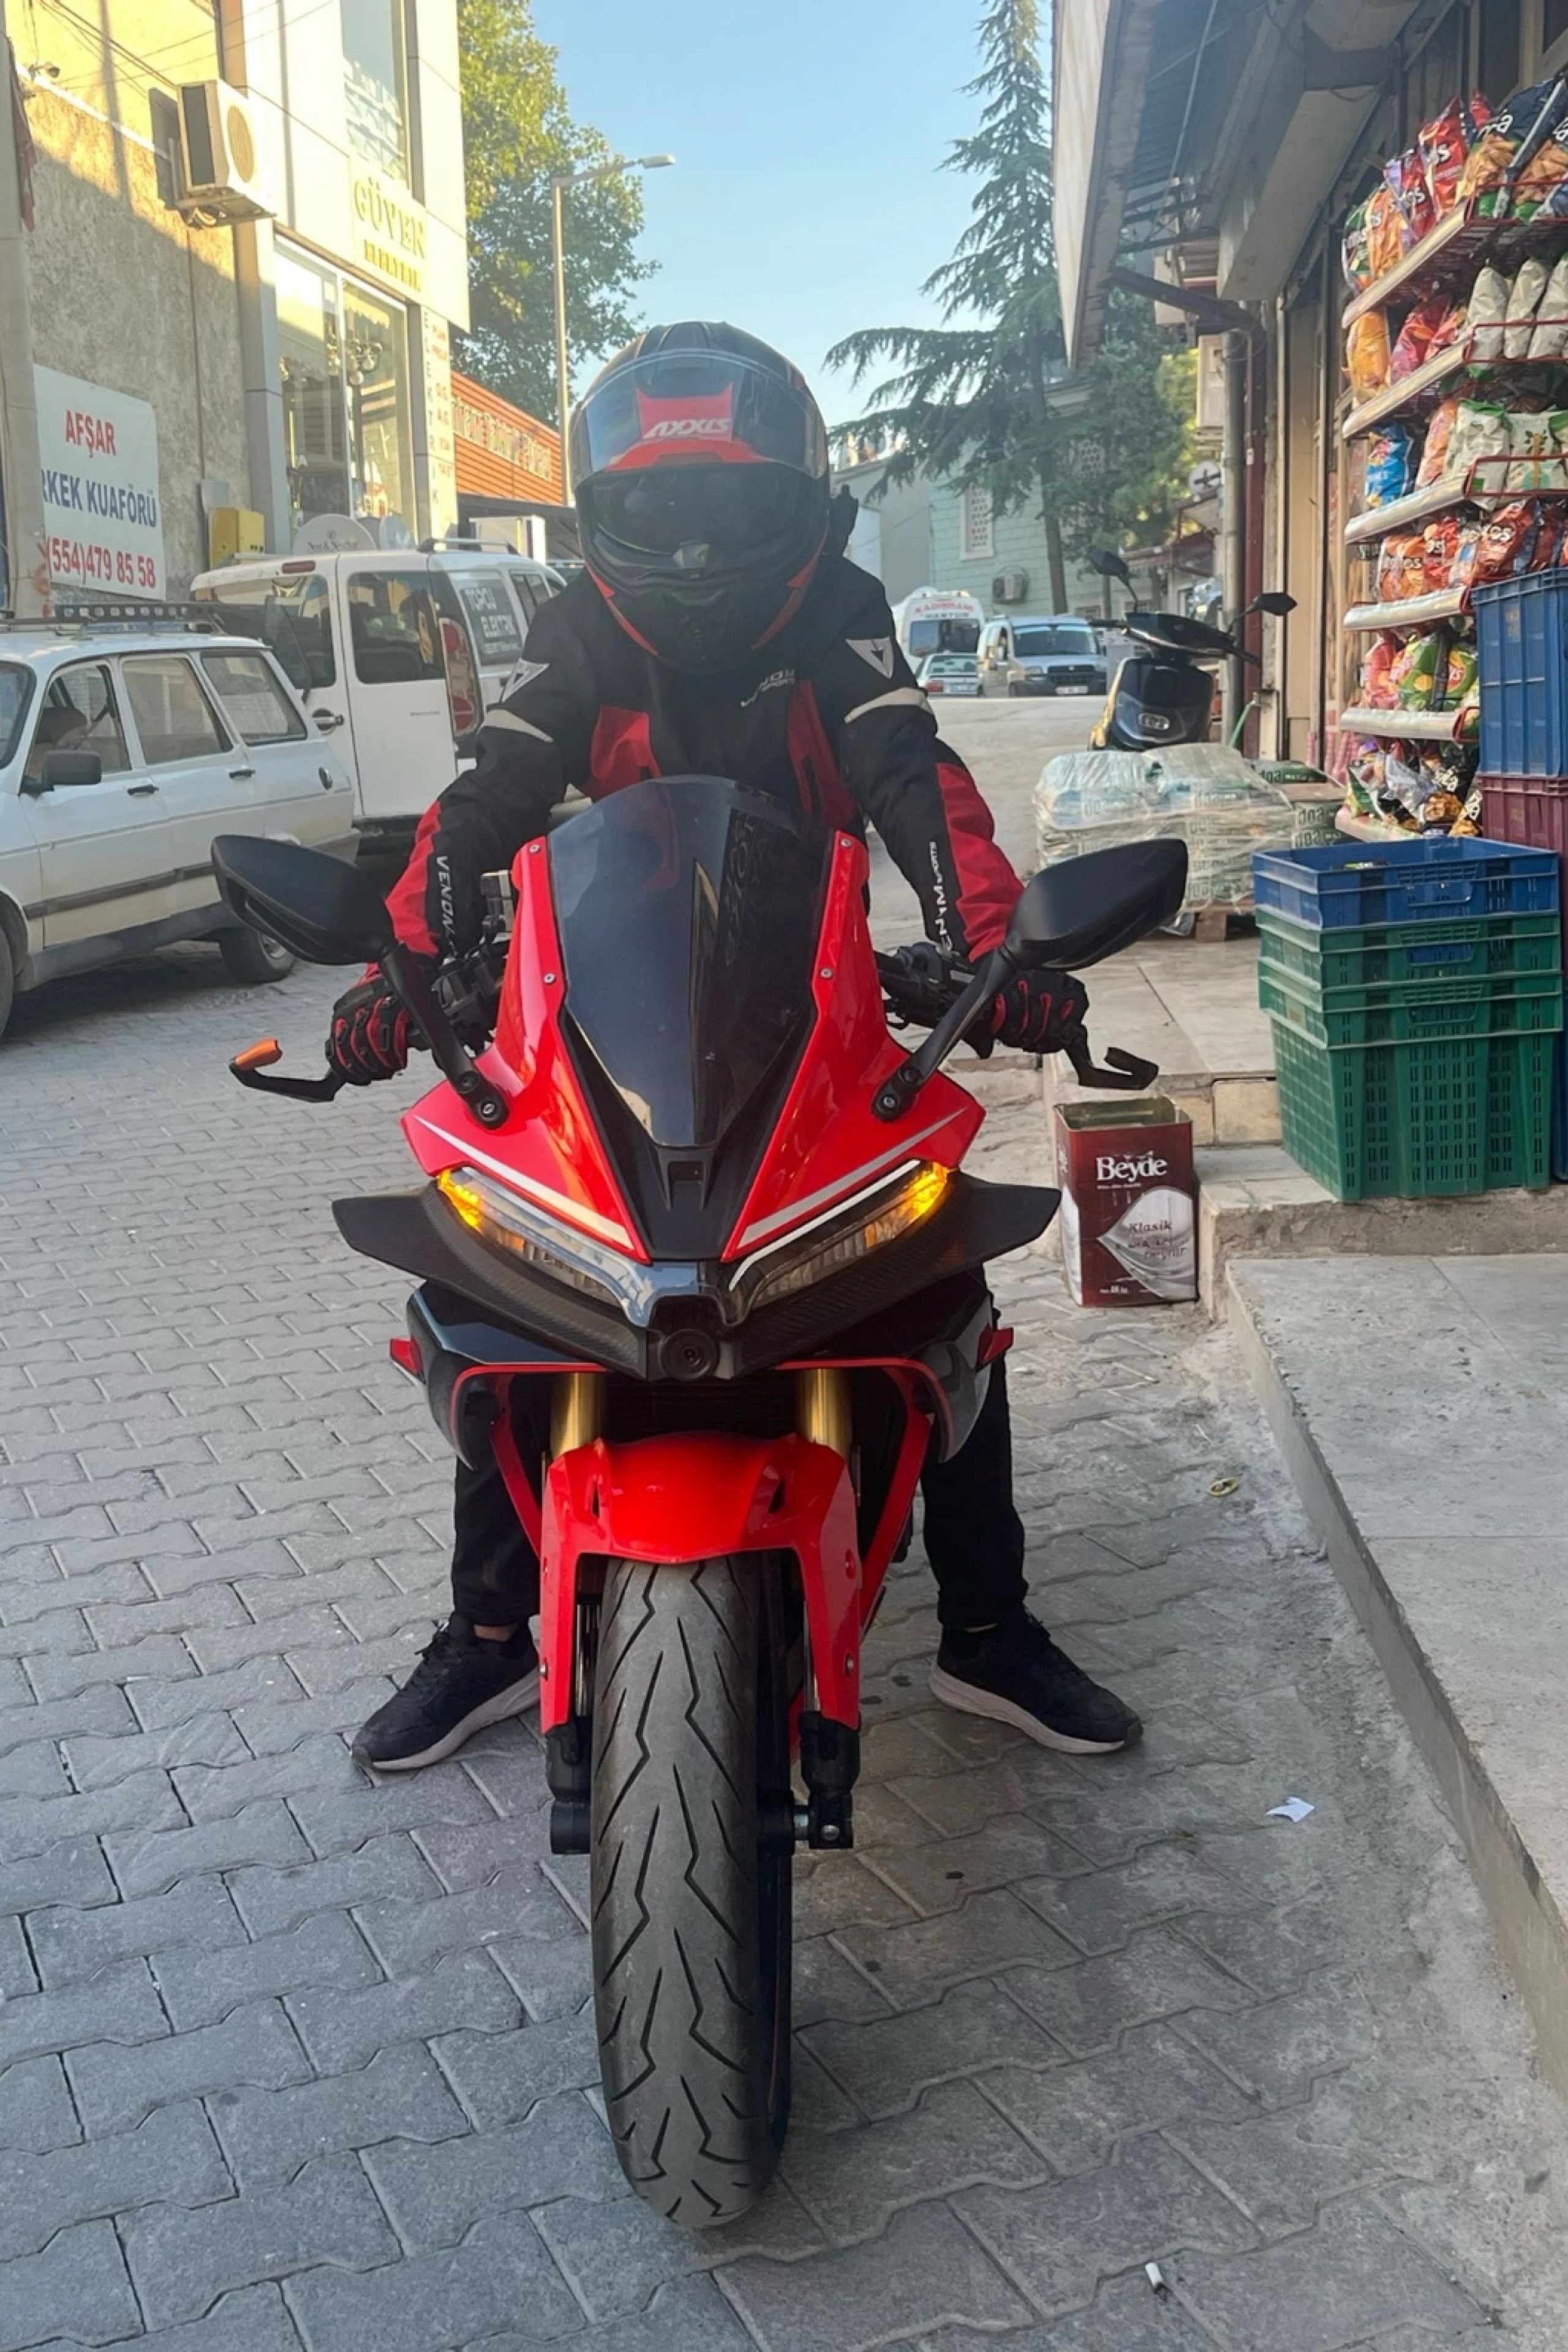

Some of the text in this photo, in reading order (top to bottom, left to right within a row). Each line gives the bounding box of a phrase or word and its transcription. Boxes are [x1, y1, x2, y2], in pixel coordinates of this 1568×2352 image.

[65, 410, 116, 458] AFŞAR
[643, 419, 731, 439] AXXIS
[86, 480, 157, 529] KUAFÖRÜ
[116, 551, 134, 585] 85
[138, 554, 156, 589] 58
[1128, 1221, 1172, 1234] Klasik
